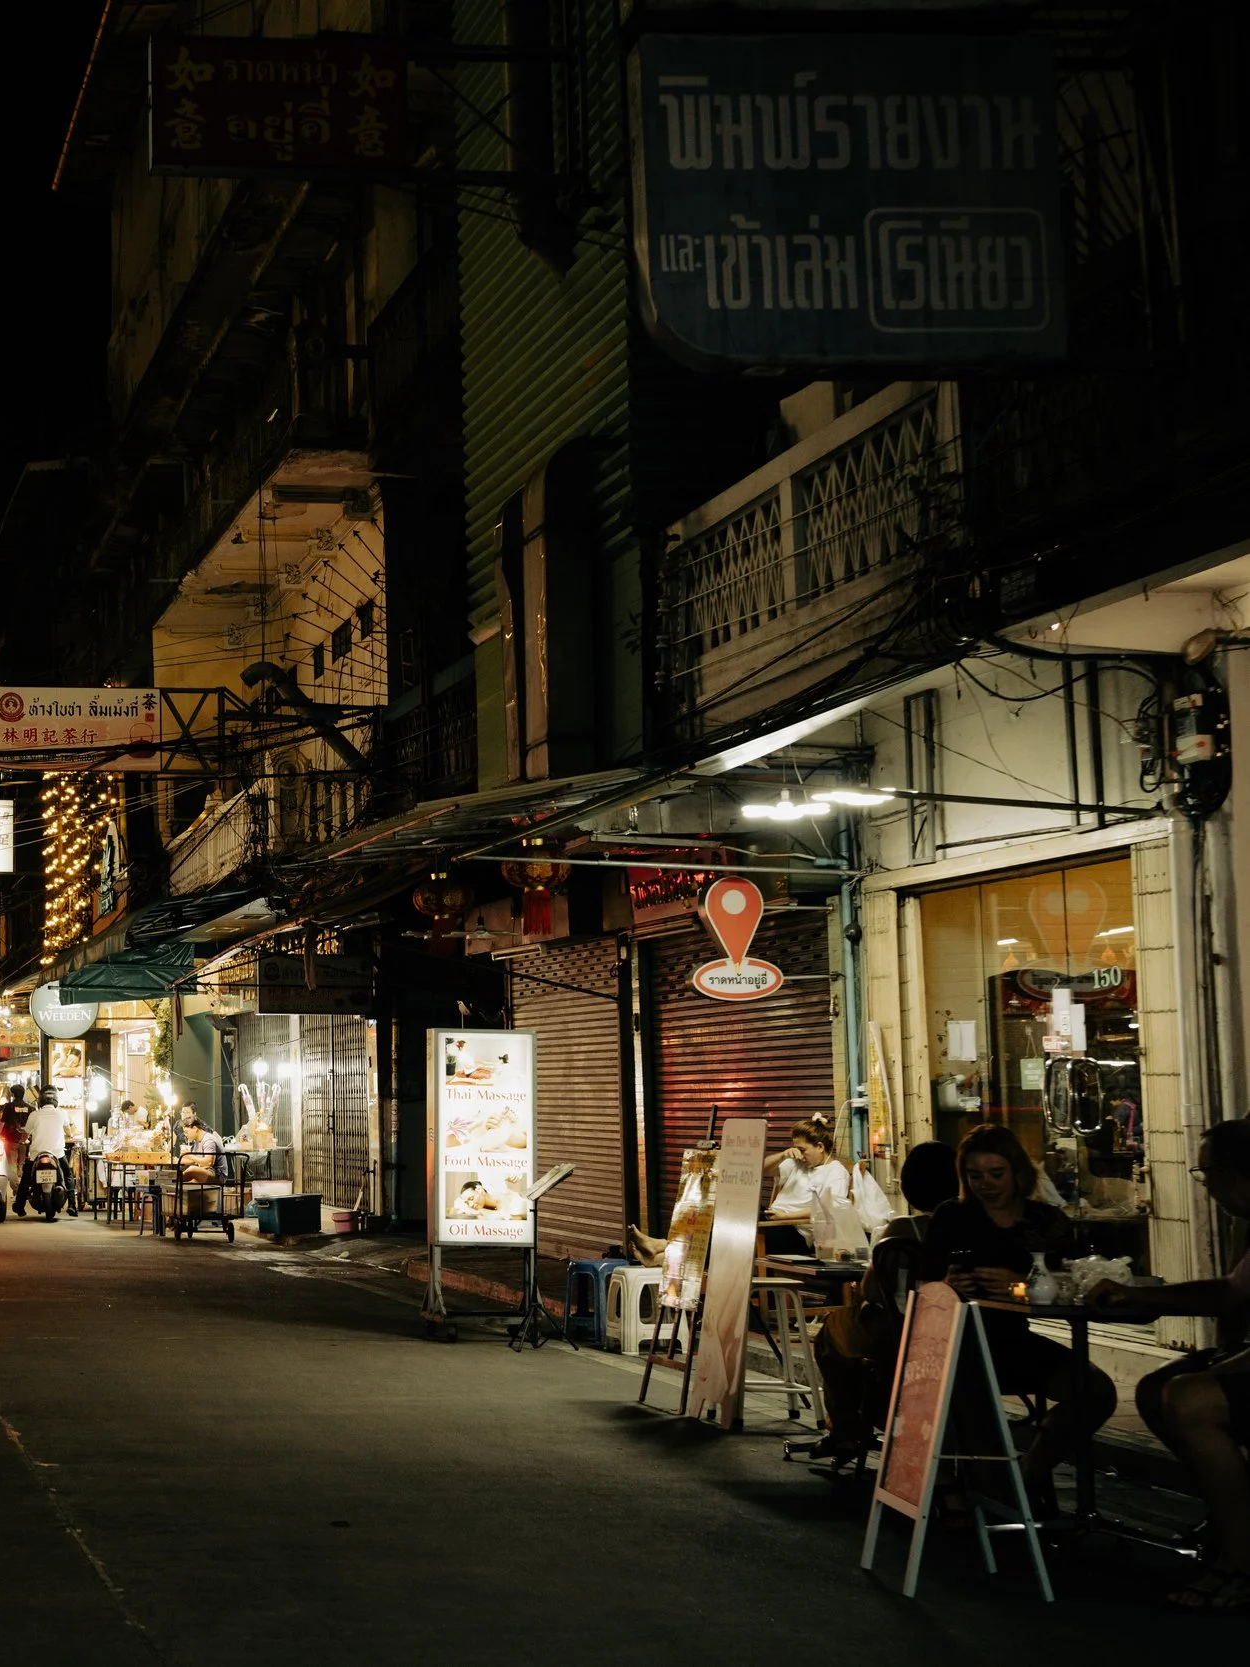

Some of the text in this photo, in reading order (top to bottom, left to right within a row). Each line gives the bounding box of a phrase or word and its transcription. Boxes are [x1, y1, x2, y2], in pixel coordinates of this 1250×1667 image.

[223, 48, 338, 86] ราดหน้า
[657, 71, 1041, 170] พิมพ์รายงาน
[141, 693, 157, 711] 茶
[3, 727, 98, 745] 林明記茶行
[1092, 965, 1122, 989] 150
[38, 1009, 92, 1022] WEEDEN
[445, 1088, 527, 1102] Thai Massage
[444, 1156, 528, 1169] Foot Massage
[449, 1223, 524, 1239] Oil Massage
